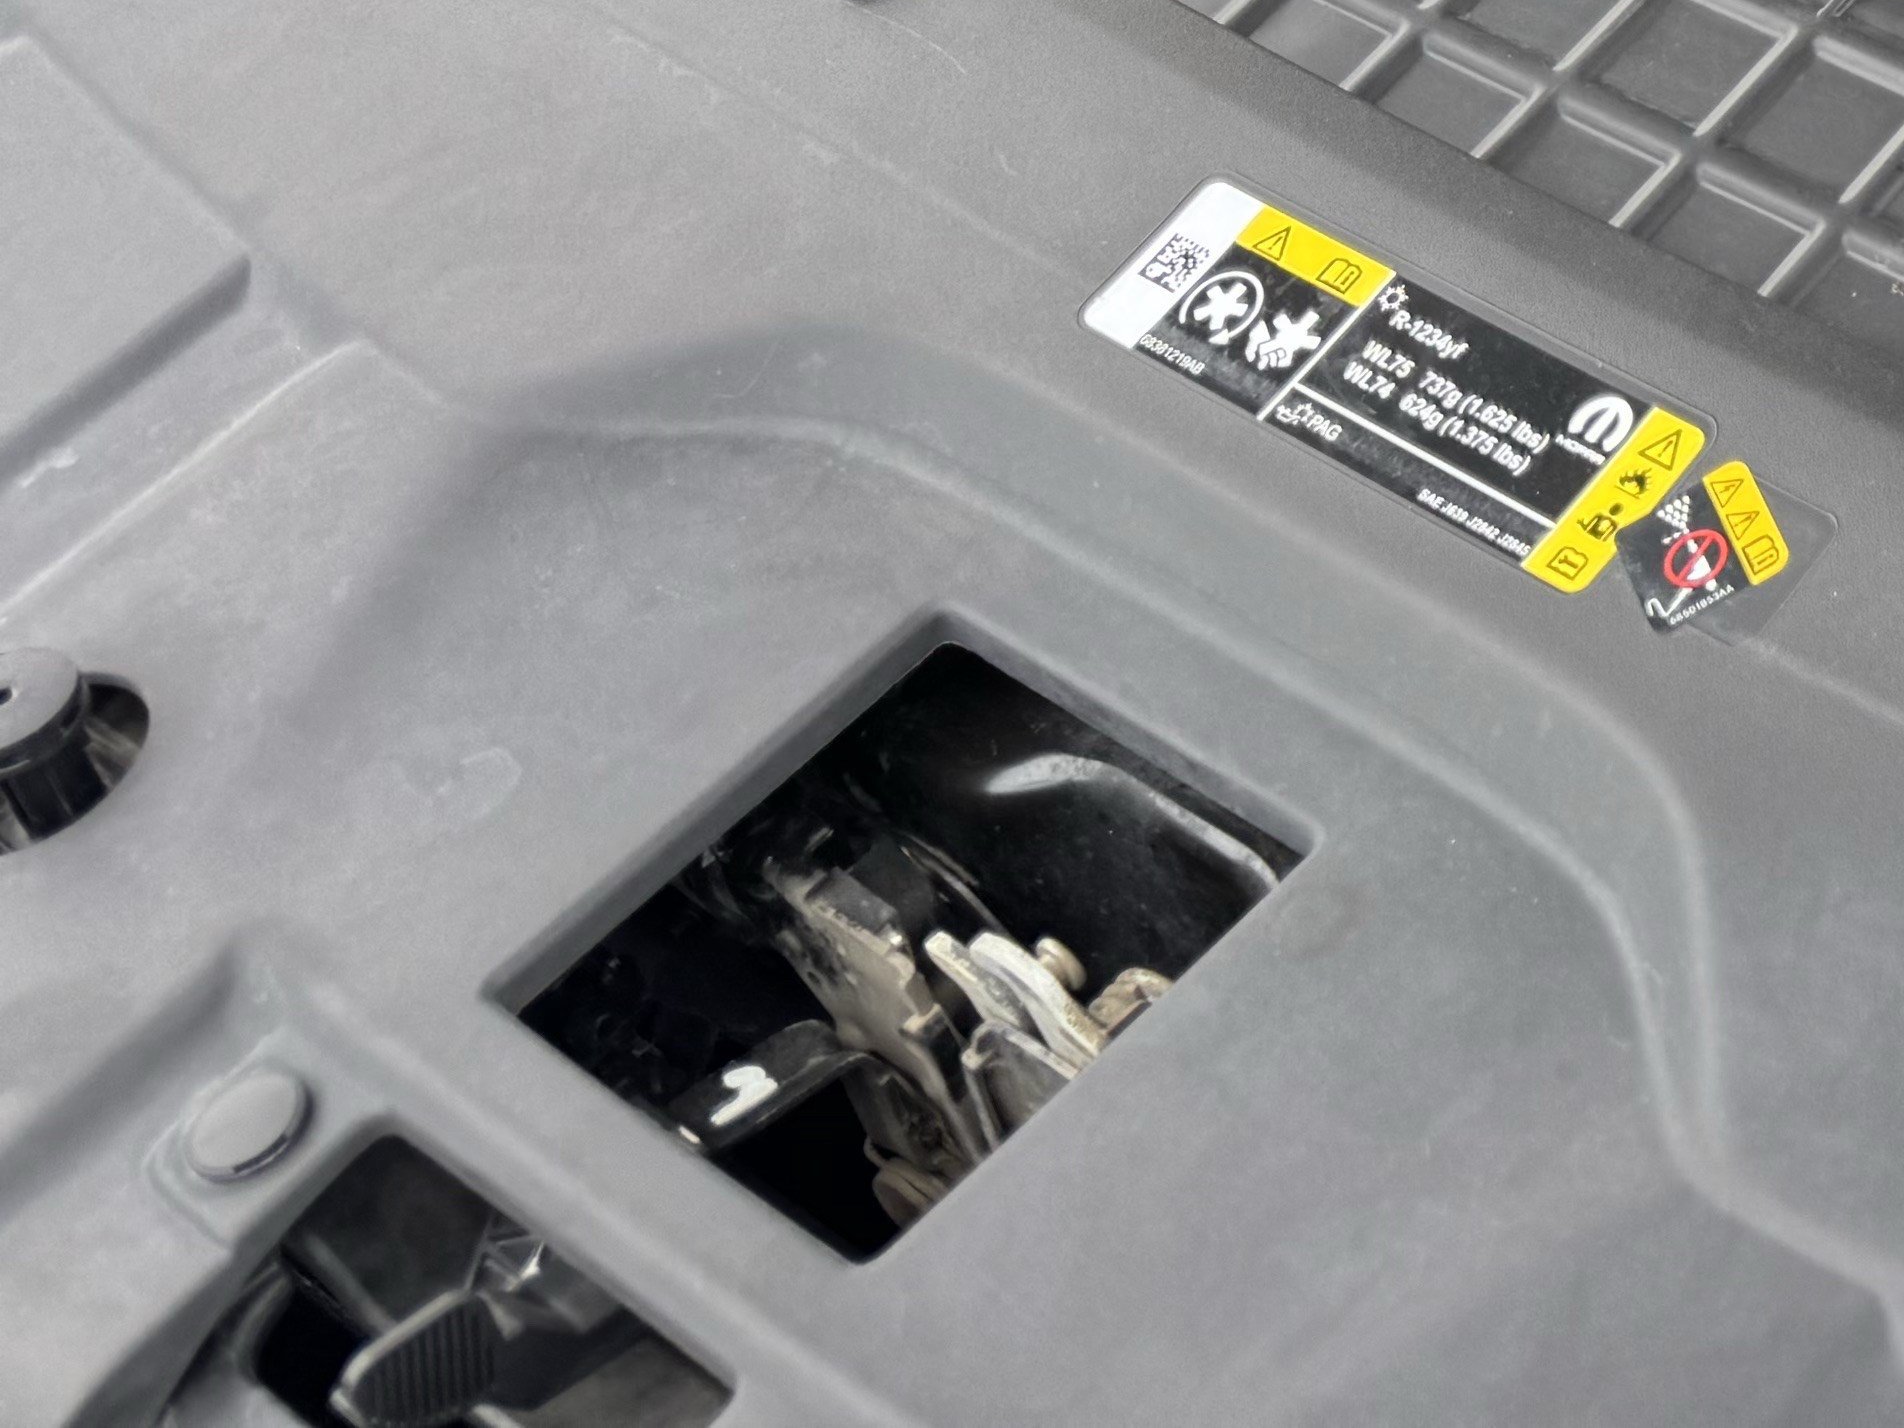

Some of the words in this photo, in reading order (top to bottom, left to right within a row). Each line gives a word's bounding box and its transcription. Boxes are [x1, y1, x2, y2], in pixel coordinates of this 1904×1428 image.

[1389, 310, 1470, 361] R-1234yf
[1342, 360, 1396, 400] WL74
[1398, 391, 1445, 432] 624g
[1438, 415, 1500, 457] (1.375
[1491, 441, 1532, 477] lbs)
[1361, 339, 1417, 379] WL75
[1418, 369, 1464, 410] 737g
[1457, 393, 1519, 435] (1.625
[1510, 419, 1551, 455] lbs)
[1305, 413, 1343, 442] PAG
[1416, 488, 1446, 510] SAE
